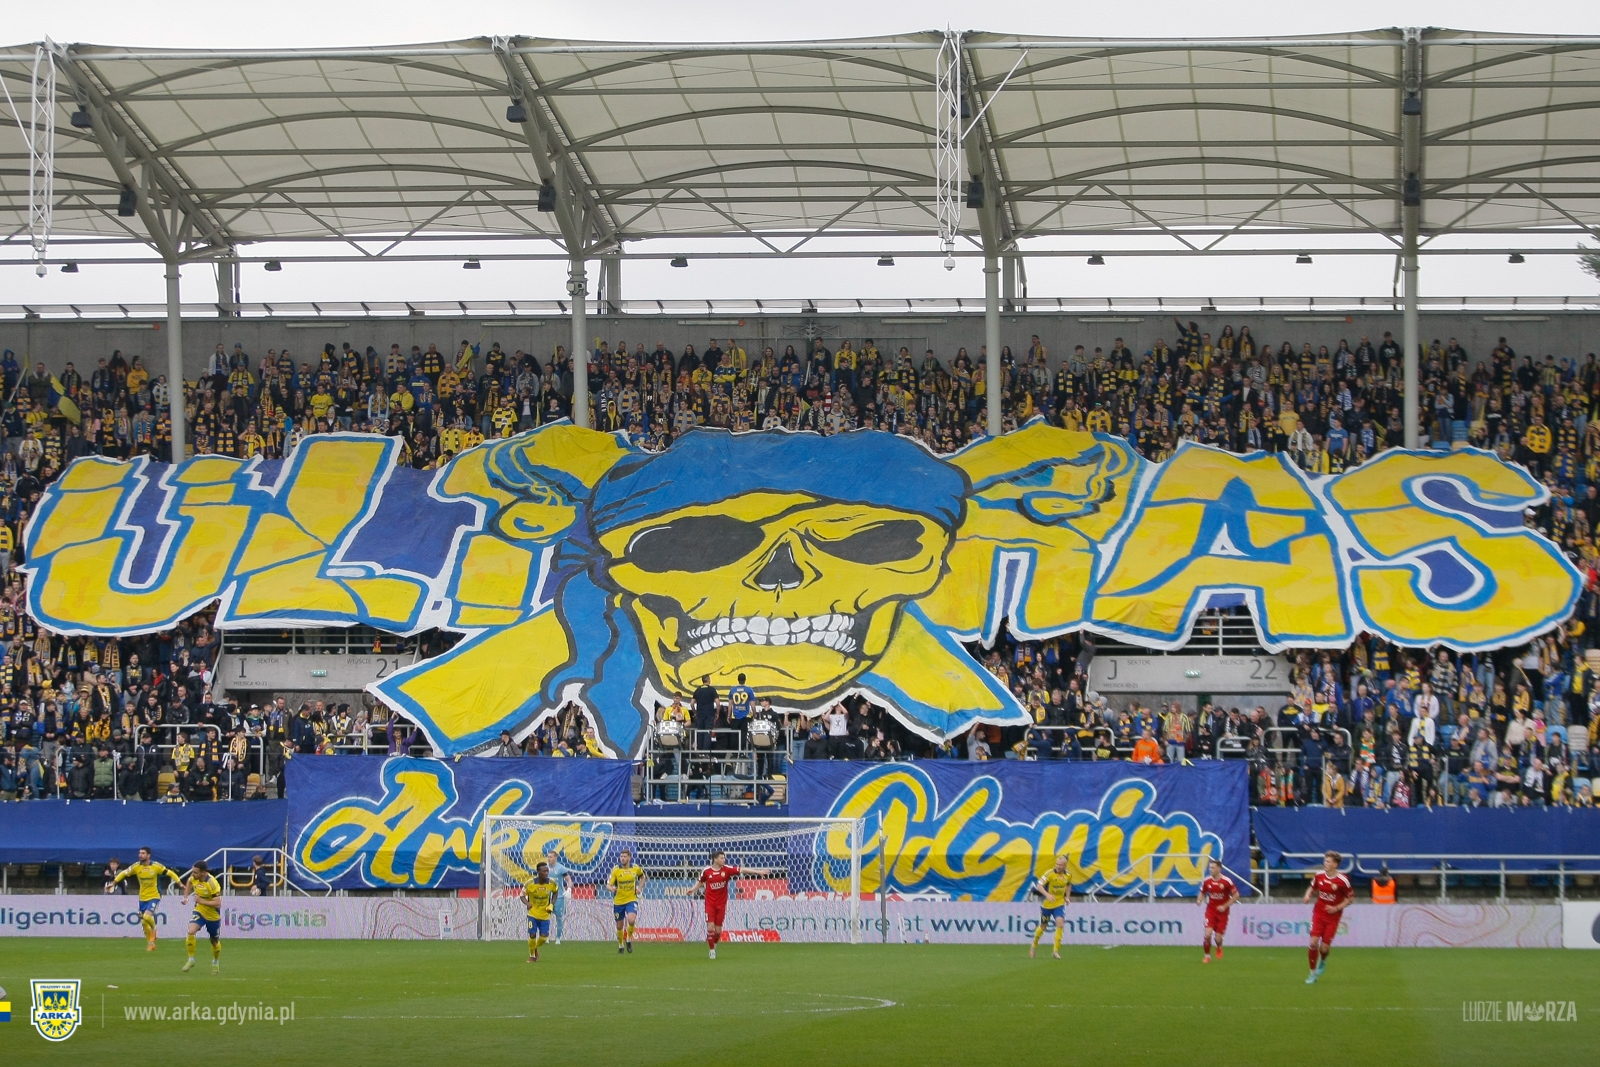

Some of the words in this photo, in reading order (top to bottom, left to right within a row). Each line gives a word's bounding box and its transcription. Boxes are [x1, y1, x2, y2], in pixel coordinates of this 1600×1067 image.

[376, 658, 399, 678] 21
[1107, 659, 1117, 680] J
[1250, 659, 1277, 680] 22
[733, 692, 748, 704] 09
[294, 758, 613, 888] Arka
[224, 908, 327, 932] ligentia
[745, 913, 817, 931] Learn
